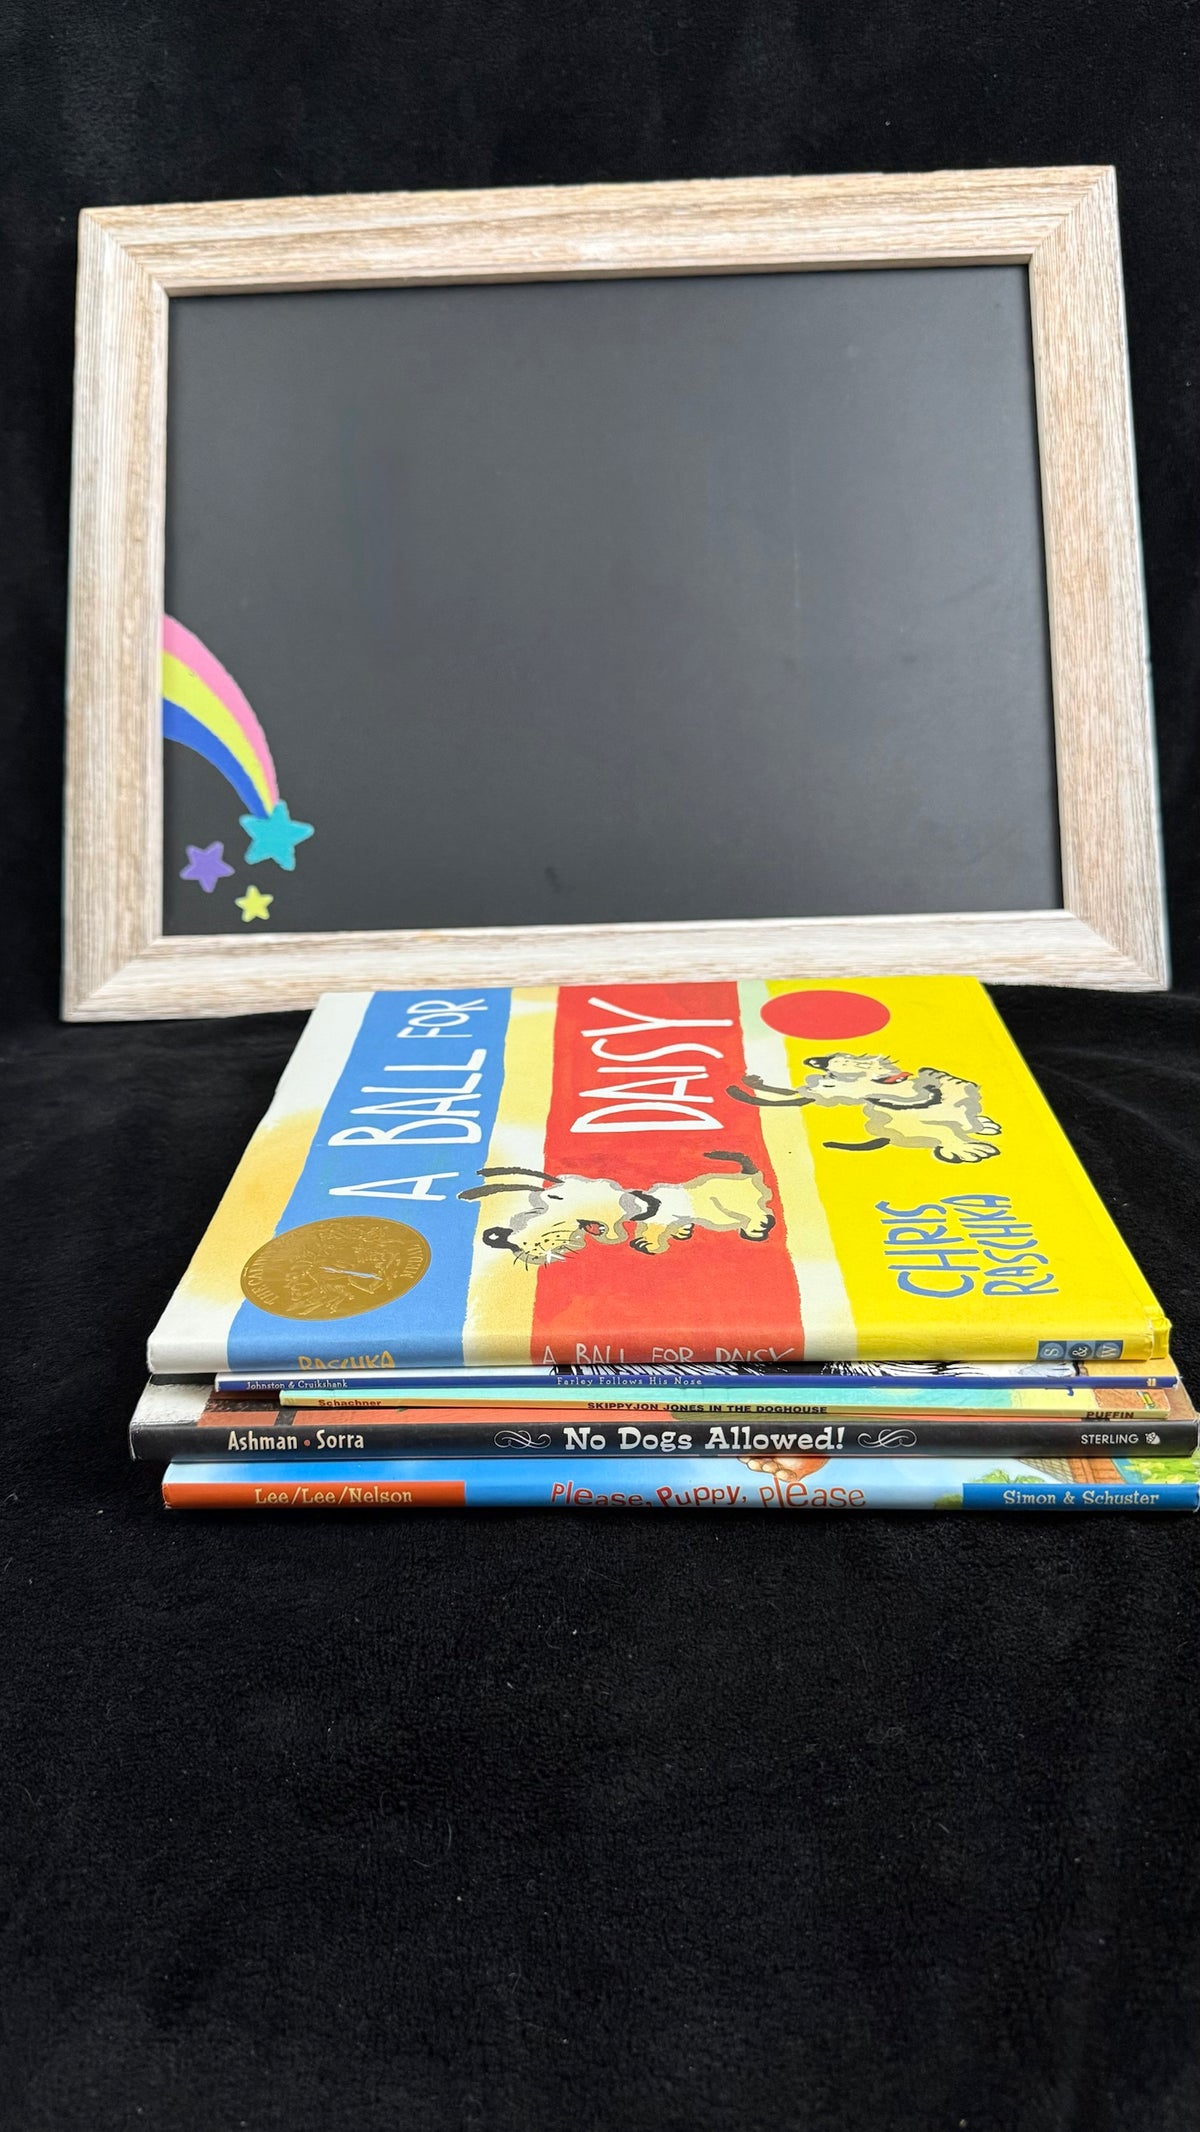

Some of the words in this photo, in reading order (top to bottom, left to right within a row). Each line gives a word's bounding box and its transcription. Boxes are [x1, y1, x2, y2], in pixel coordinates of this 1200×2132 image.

[396, 998, 489, 1039] FOR
[569, 996, 734, 1134] DAISY
[327, 1048, 487, 1147] BALL
[328, 1171, 460, 1201] A
[874, 1200, 982, 1299] CHRIS
[939, 1193, 1060, 1297] RASCHKA
[298, 1350, 396, 1370] RASCHKA
[542, 1345, 557, 1364] A
[575, 1343, 627, 1364] BALL
[652, 1347, 695, 1362] FOR
[715, 1347, 795, 1362] DAISY
[246, 1381, 286, 1391] Johnston
[287, 1380, 296, 1389] &
[297, 1378, 349, 1389] Cruikshank
[557, 1376, 593, 1387] Farley
[599, 1376, 644, 1386] Follows
[649, 1376, 668, 1386] His
[674, 1376, 702, 1386] Nose
[318, 1399, 382, 1407] Schachner
[587, 1402, 659, 1411] SKIPPYJON
[663, 1403, 705, 1413] JONES
[709, 1404, 722, 1413] IN
[726, 1404, 751, 1413] THE
[755, 1405, 828, 1414] DOGHOUSE
[1086, 1411, 1134, 1419] PUFFIN
[227, 1430, 299, 1451] Ashman
[316, 1429, 365, 1450] Sorra
[563, 1427, 606, 1450] No
[617, 1427, 693, 1452] Dogs
[704, 1425, 845, 1450] Allowed!
[1080, 1433, 1140, 1445] STERLING
[254, 1486, 413, 1505] Lee/Lee/Nelson
[656, 1485, 747, 1507] Puppy,
[1002, 1489, 1056, 1505] Simon
[1062, 1491, 1075, 1505] &
[1081, 1490, 1159, 1505] Schuster
